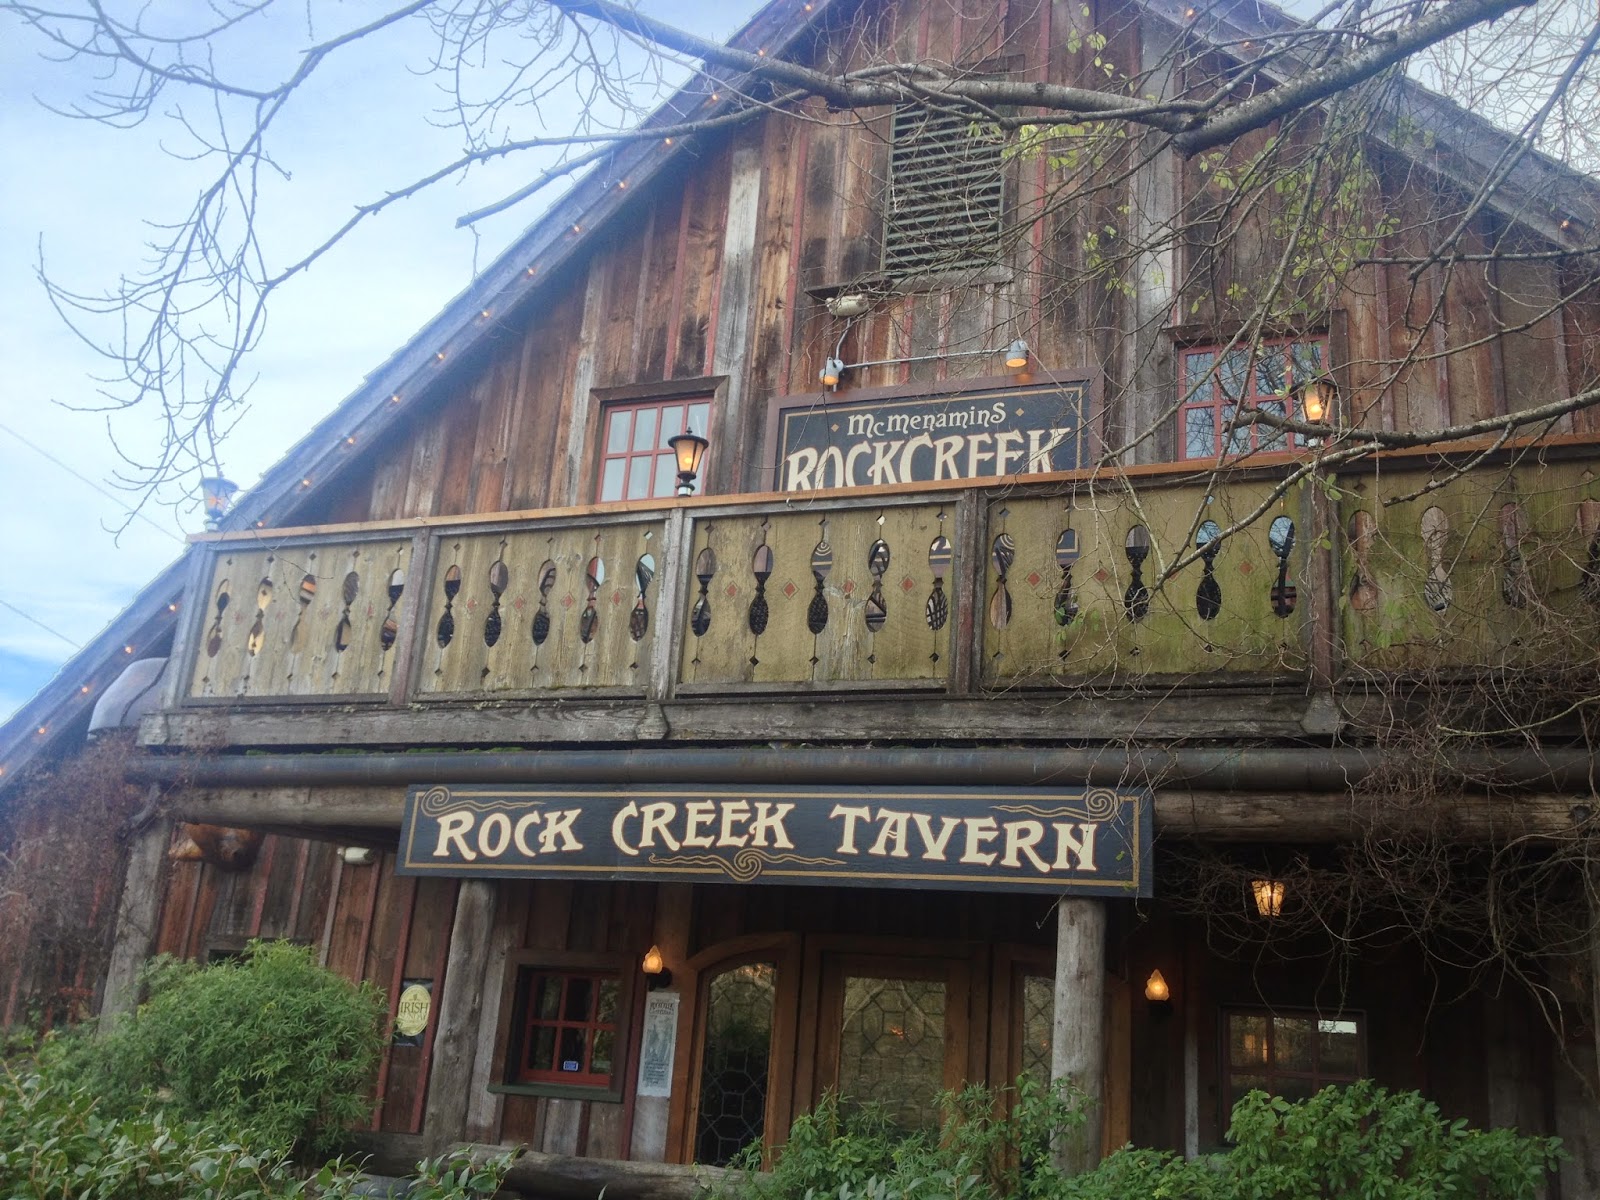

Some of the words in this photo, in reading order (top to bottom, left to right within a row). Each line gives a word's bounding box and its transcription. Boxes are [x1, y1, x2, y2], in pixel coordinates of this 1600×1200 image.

[433, 808, 583, 860] ROCK
[611, 800, 796, 856] CREEK
[829, 803, 1098, 873] TAVERN
[400, 1001, 428, 1014] IRISH
